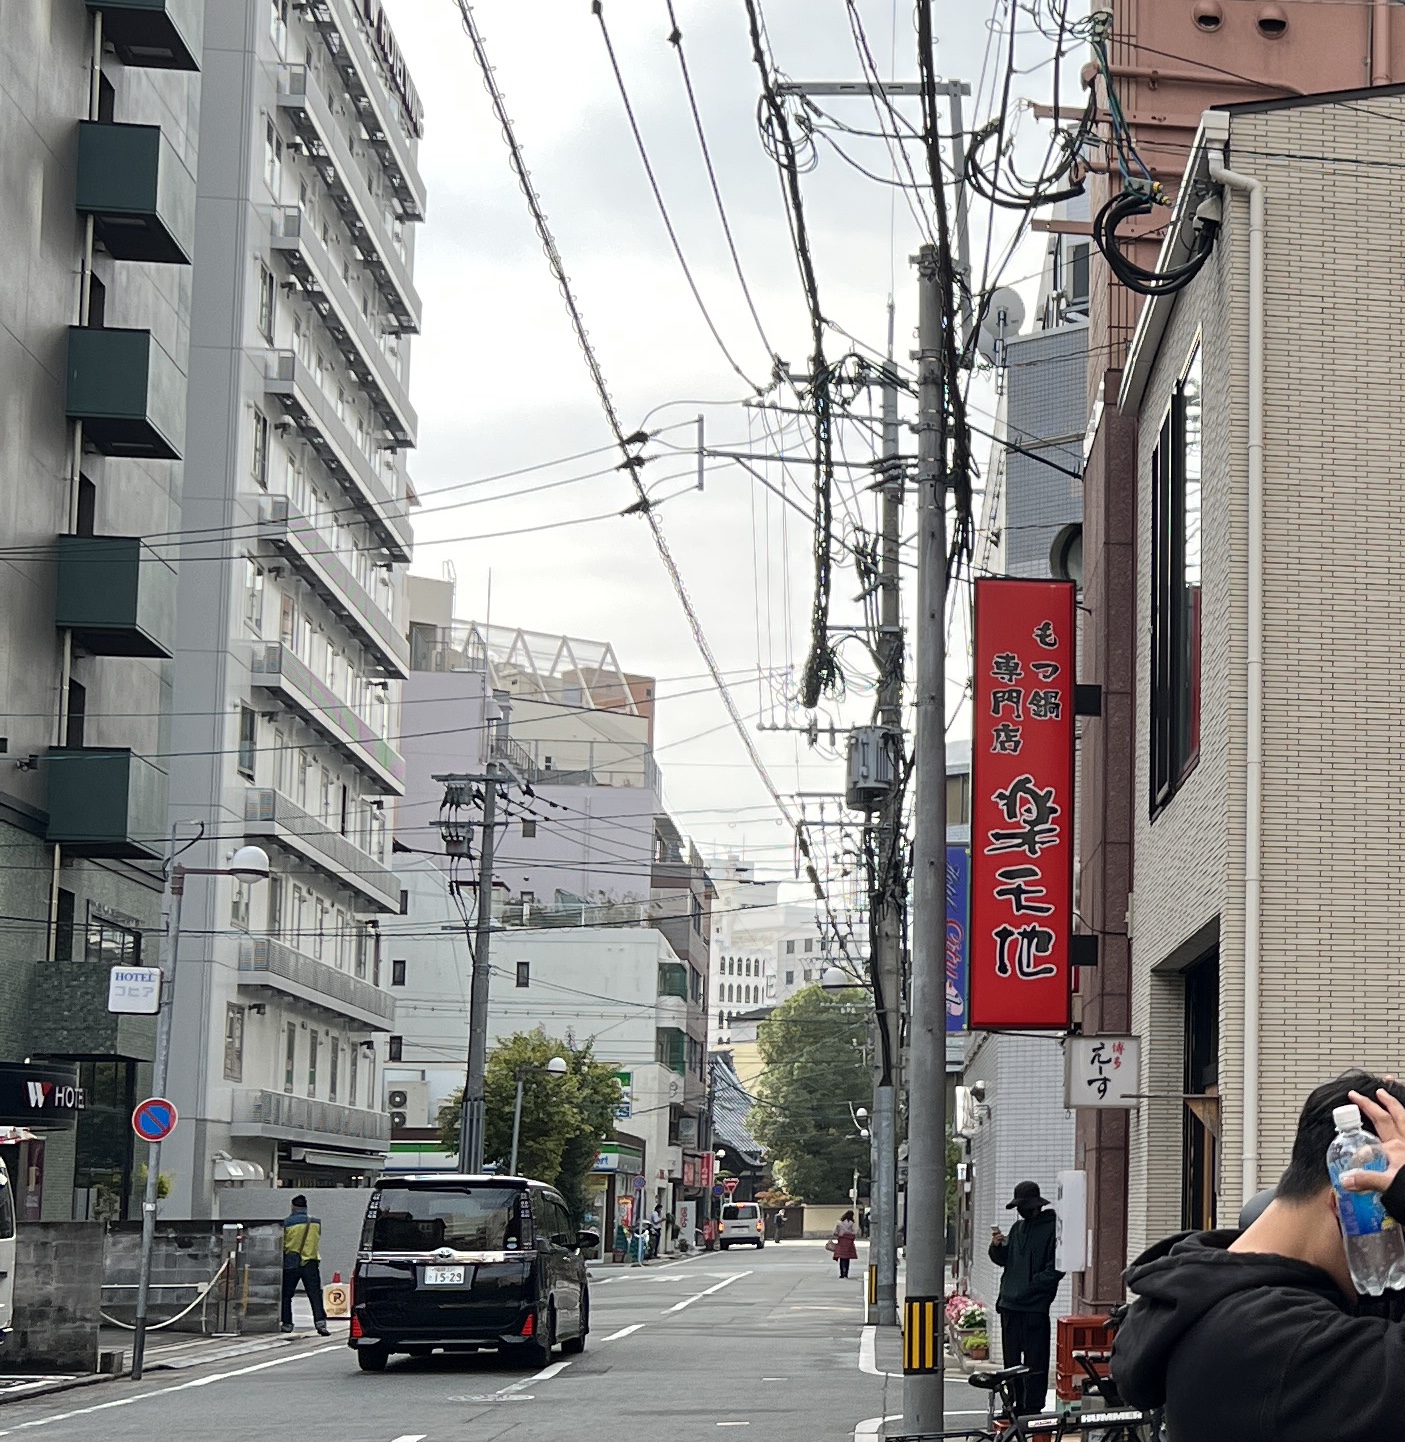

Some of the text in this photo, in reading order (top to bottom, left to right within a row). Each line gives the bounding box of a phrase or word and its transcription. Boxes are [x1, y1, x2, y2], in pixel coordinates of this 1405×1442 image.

[1027, 620, 1063, 721] もつ鍋
[989, 652, 1023, 755] 専門店
[115, 972, 156, 983] HOTEL
[1080, 1410, 1143, 1424] HUMMER
